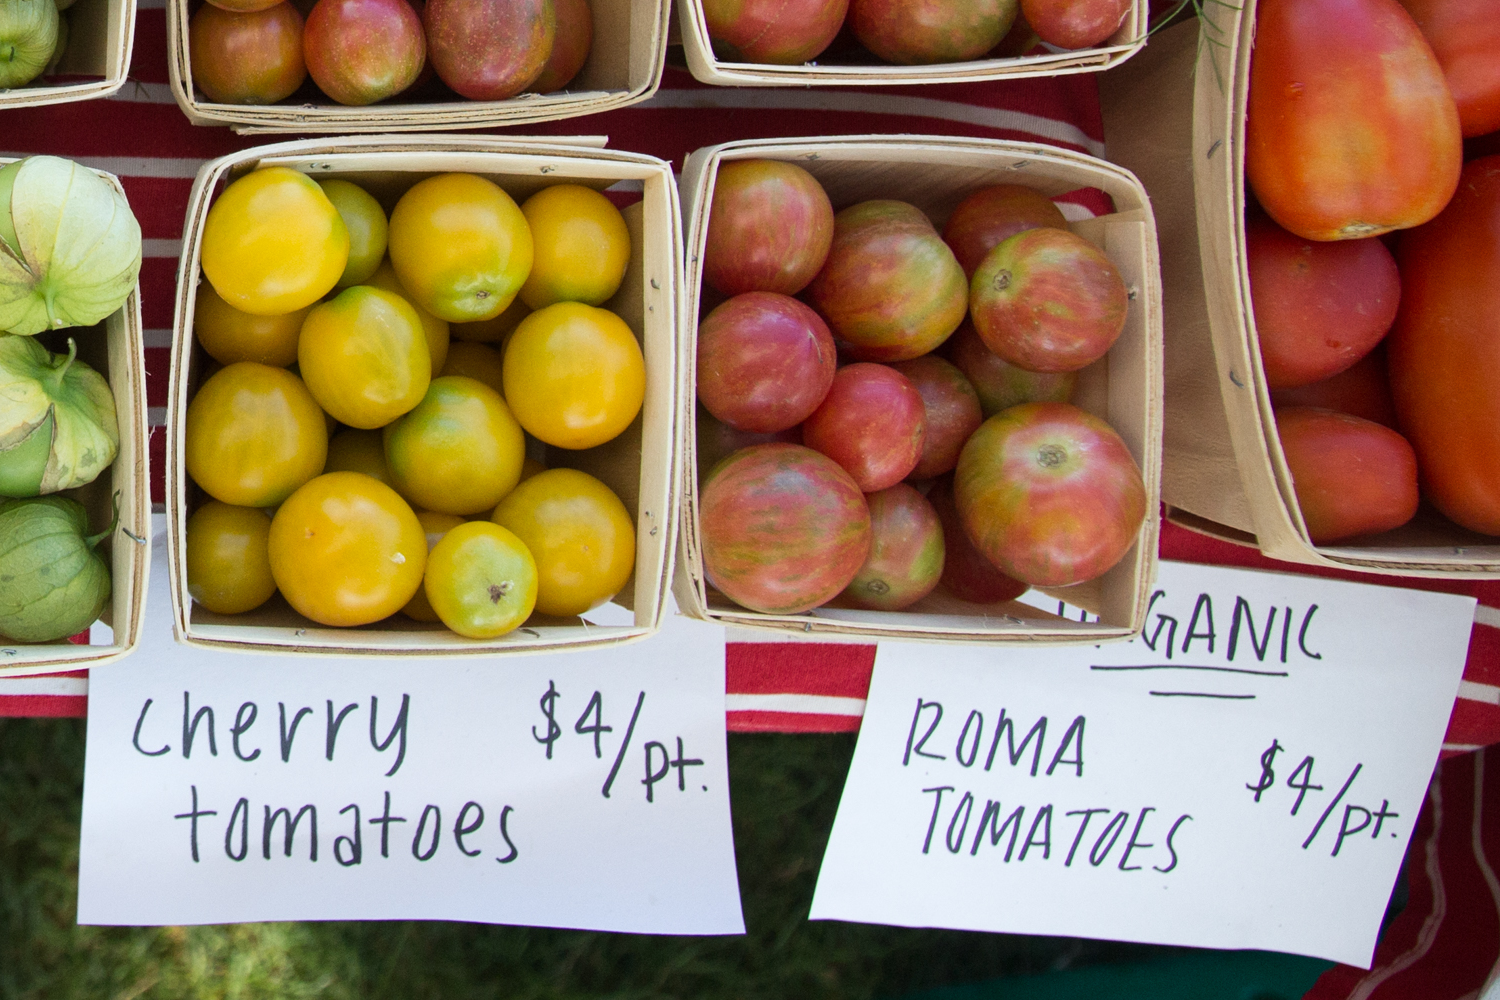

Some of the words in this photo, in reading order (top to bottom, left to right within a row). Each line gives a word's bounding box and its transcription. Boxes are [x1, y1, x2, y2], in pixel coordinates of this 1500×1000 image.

[531, 679, 710, 804] $4/pt.
[902, 697, 1087, 778] ROMA
[173, 784, 520, 868] tomatoes
[921, 785, 1194, 874] TOMATOES
[1245, 737, 1400, 858] $4/pt.
